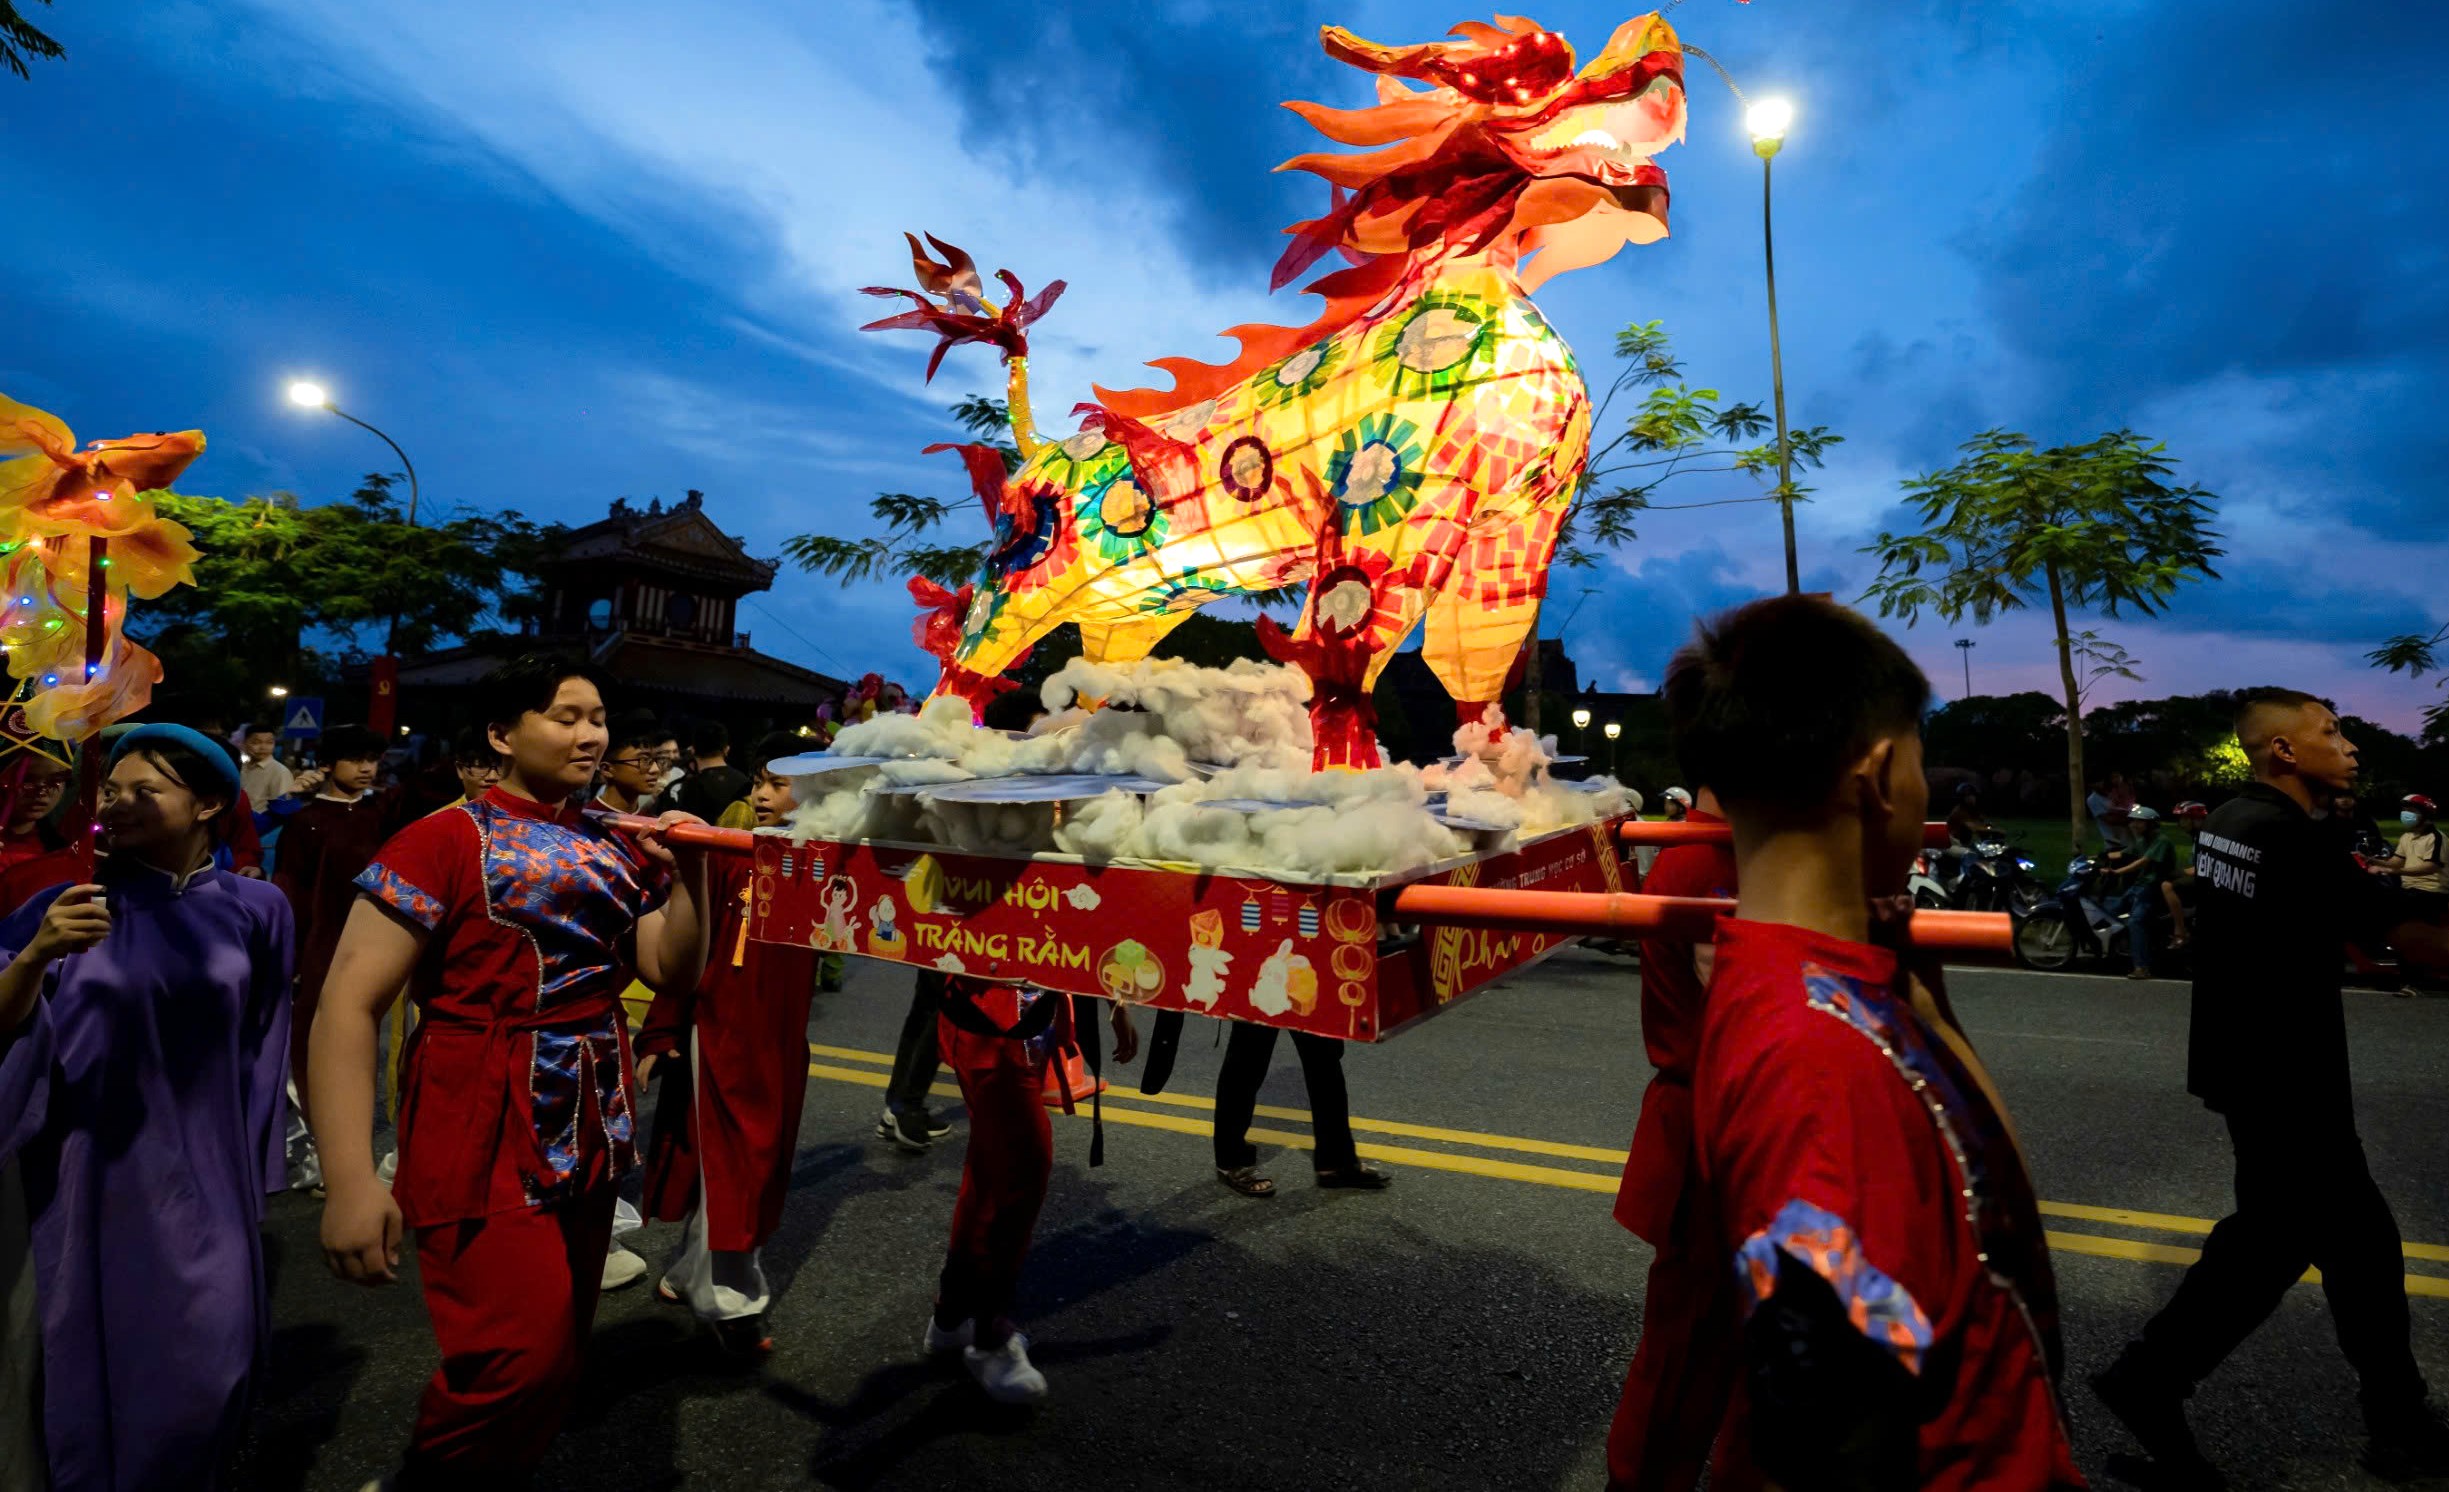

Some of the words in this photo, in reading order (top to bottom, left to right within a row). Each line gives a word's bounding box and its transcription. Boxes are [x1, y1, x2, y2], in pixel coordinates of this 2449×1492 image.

[2228, 840, 2263, 864] DANCE
[944, 875, 993, 904] VUI
[1003, 876, 1060, 919] HỘI
[1518, 866, 1546, 888] TRUNG
[2213, 859, 2257, 899] QUANG
[914, 920, 1009, 961] TRĂNG
[1016, 924, 1091, 972] RẰM
